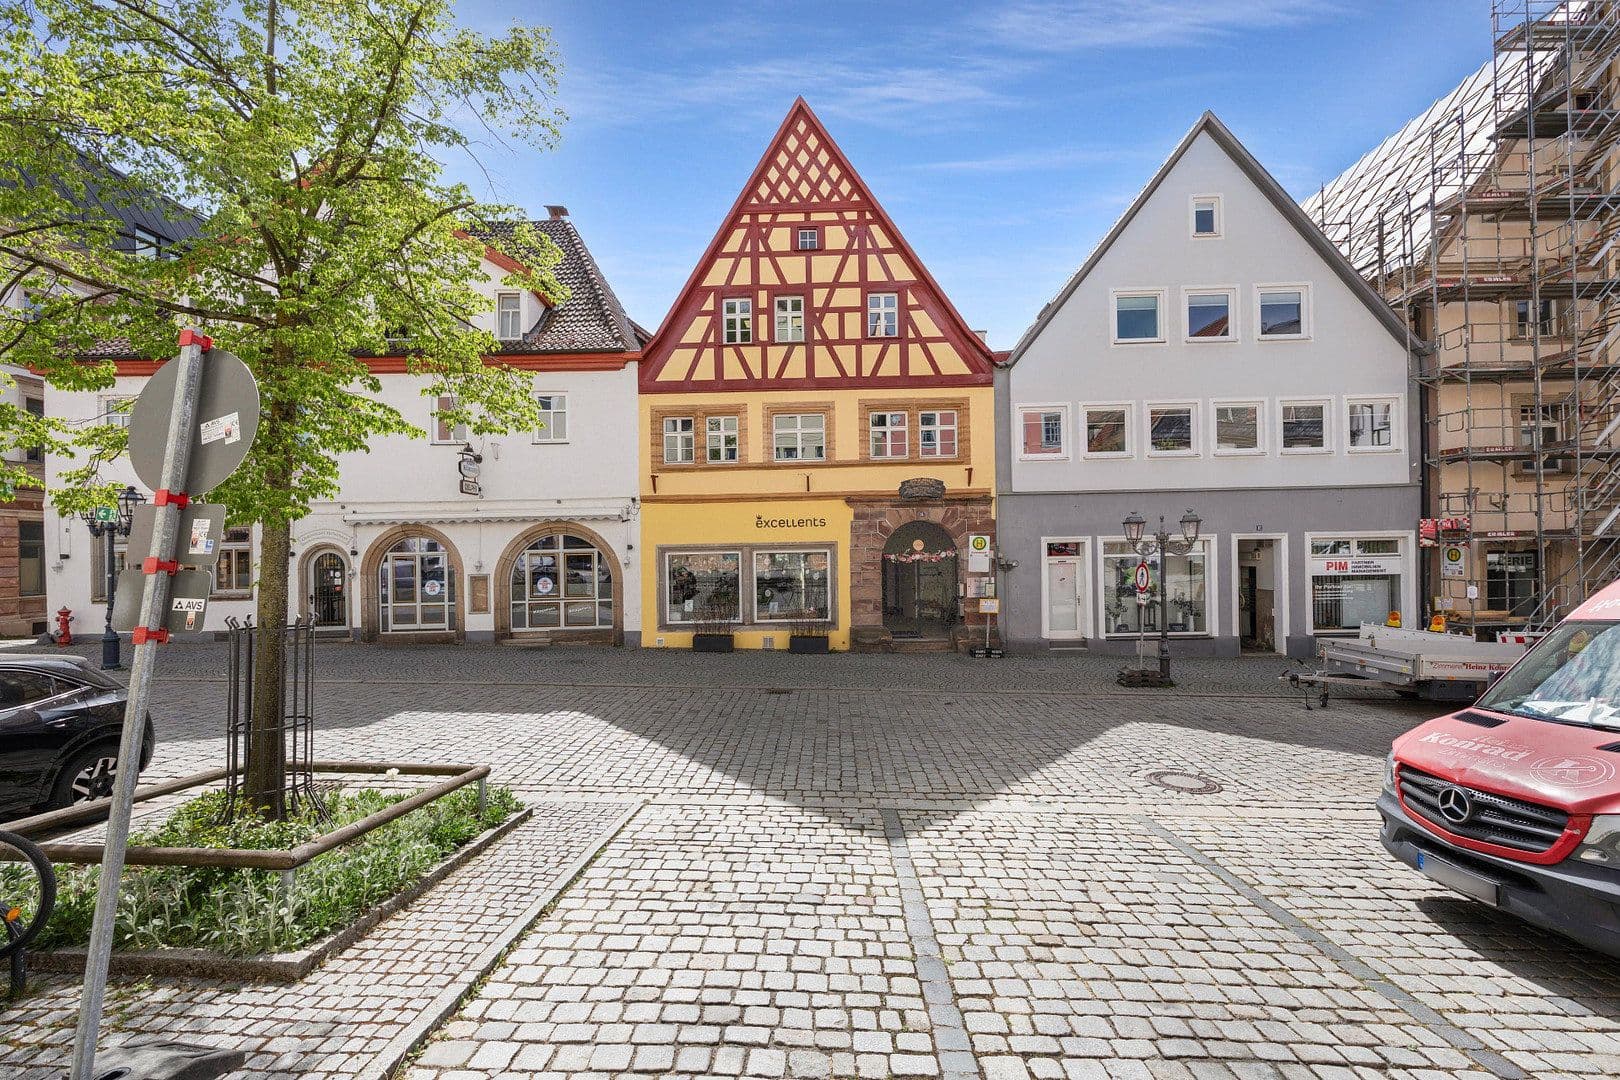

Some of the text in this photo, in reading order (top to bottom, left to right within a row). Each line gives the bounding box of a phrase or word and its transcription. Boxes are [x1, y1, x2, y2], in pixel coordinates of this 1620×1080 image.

[755, 515, 826, 528] excellents
[1326, 561, 1348, 571] PIM
[185, 601, 203, 610] AVS
[1465, 663, 1487, 671] Heinz
[1418, 732, 1535, 762] Konrad
